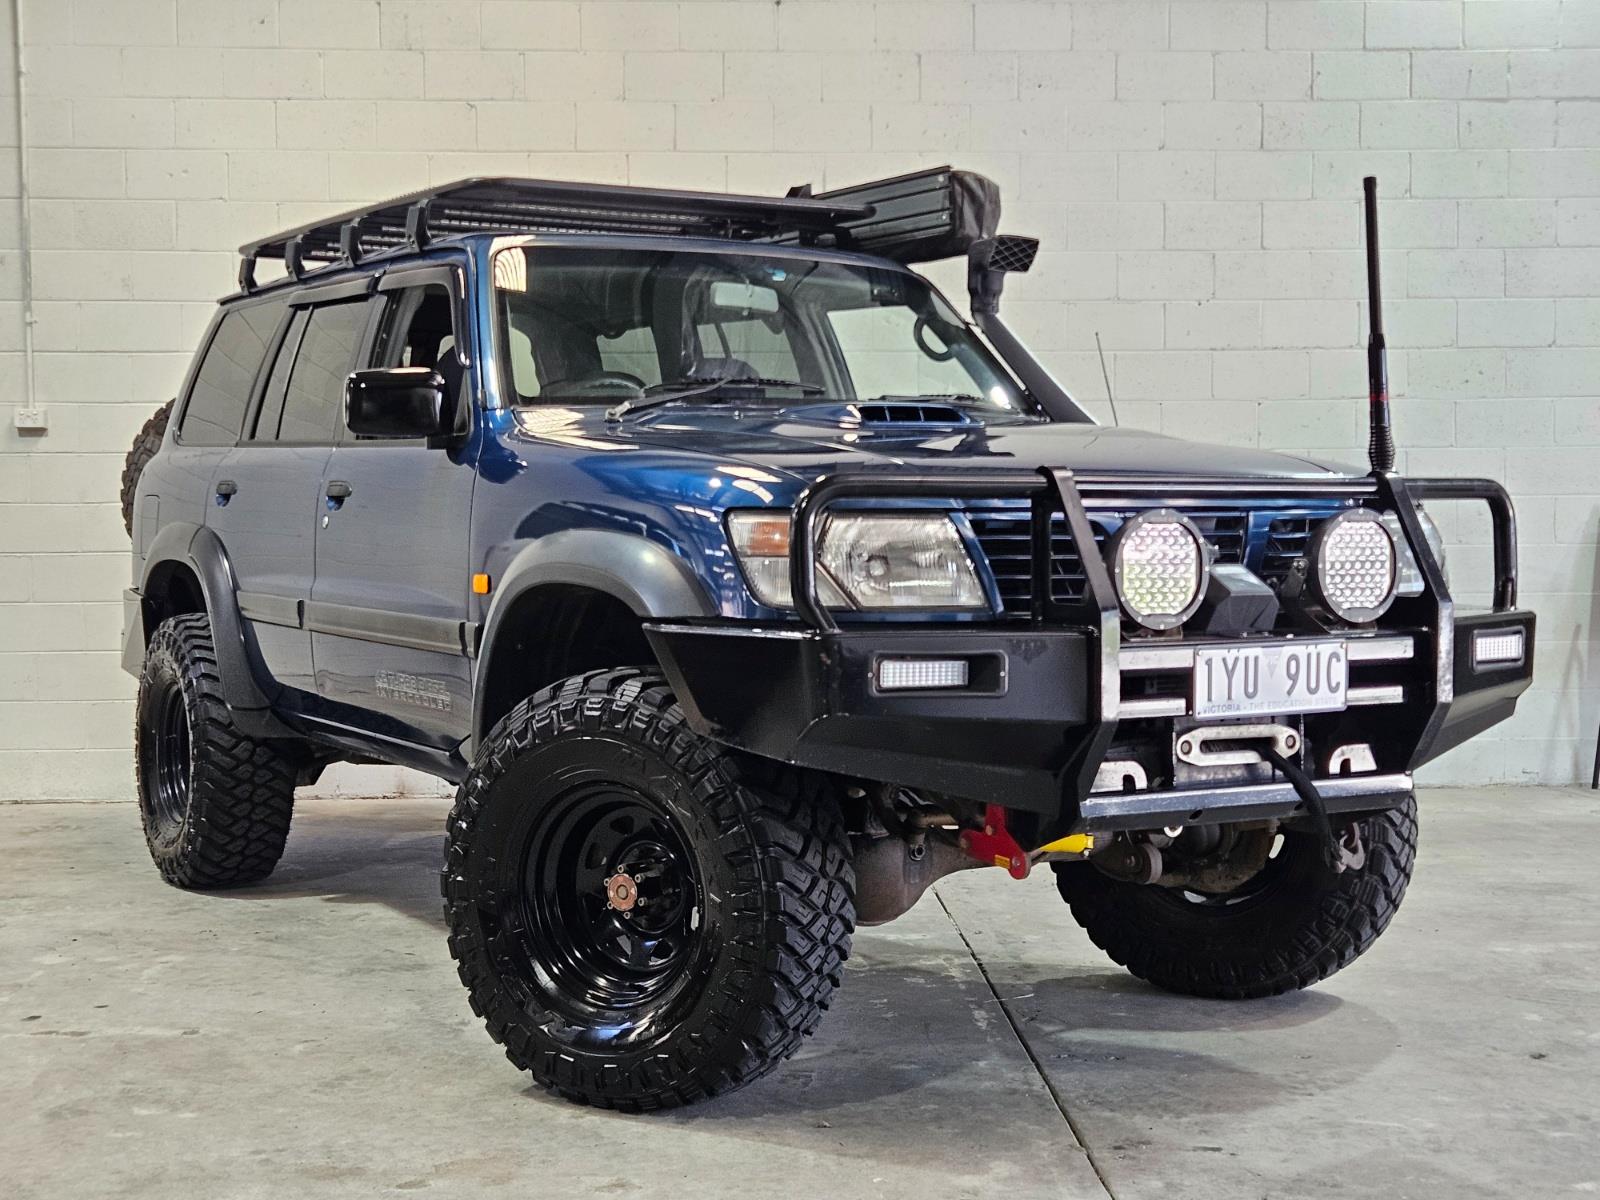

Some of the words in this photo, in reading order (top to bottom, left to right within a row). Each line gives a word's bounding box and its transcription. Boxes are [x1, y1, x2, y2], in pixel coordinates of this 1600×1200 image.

[1205, 656, 1259, 702] 1YU
[1286, 651, 1341, 696] 9UC
[1203, 703, 1241, 714] VICTORIA
